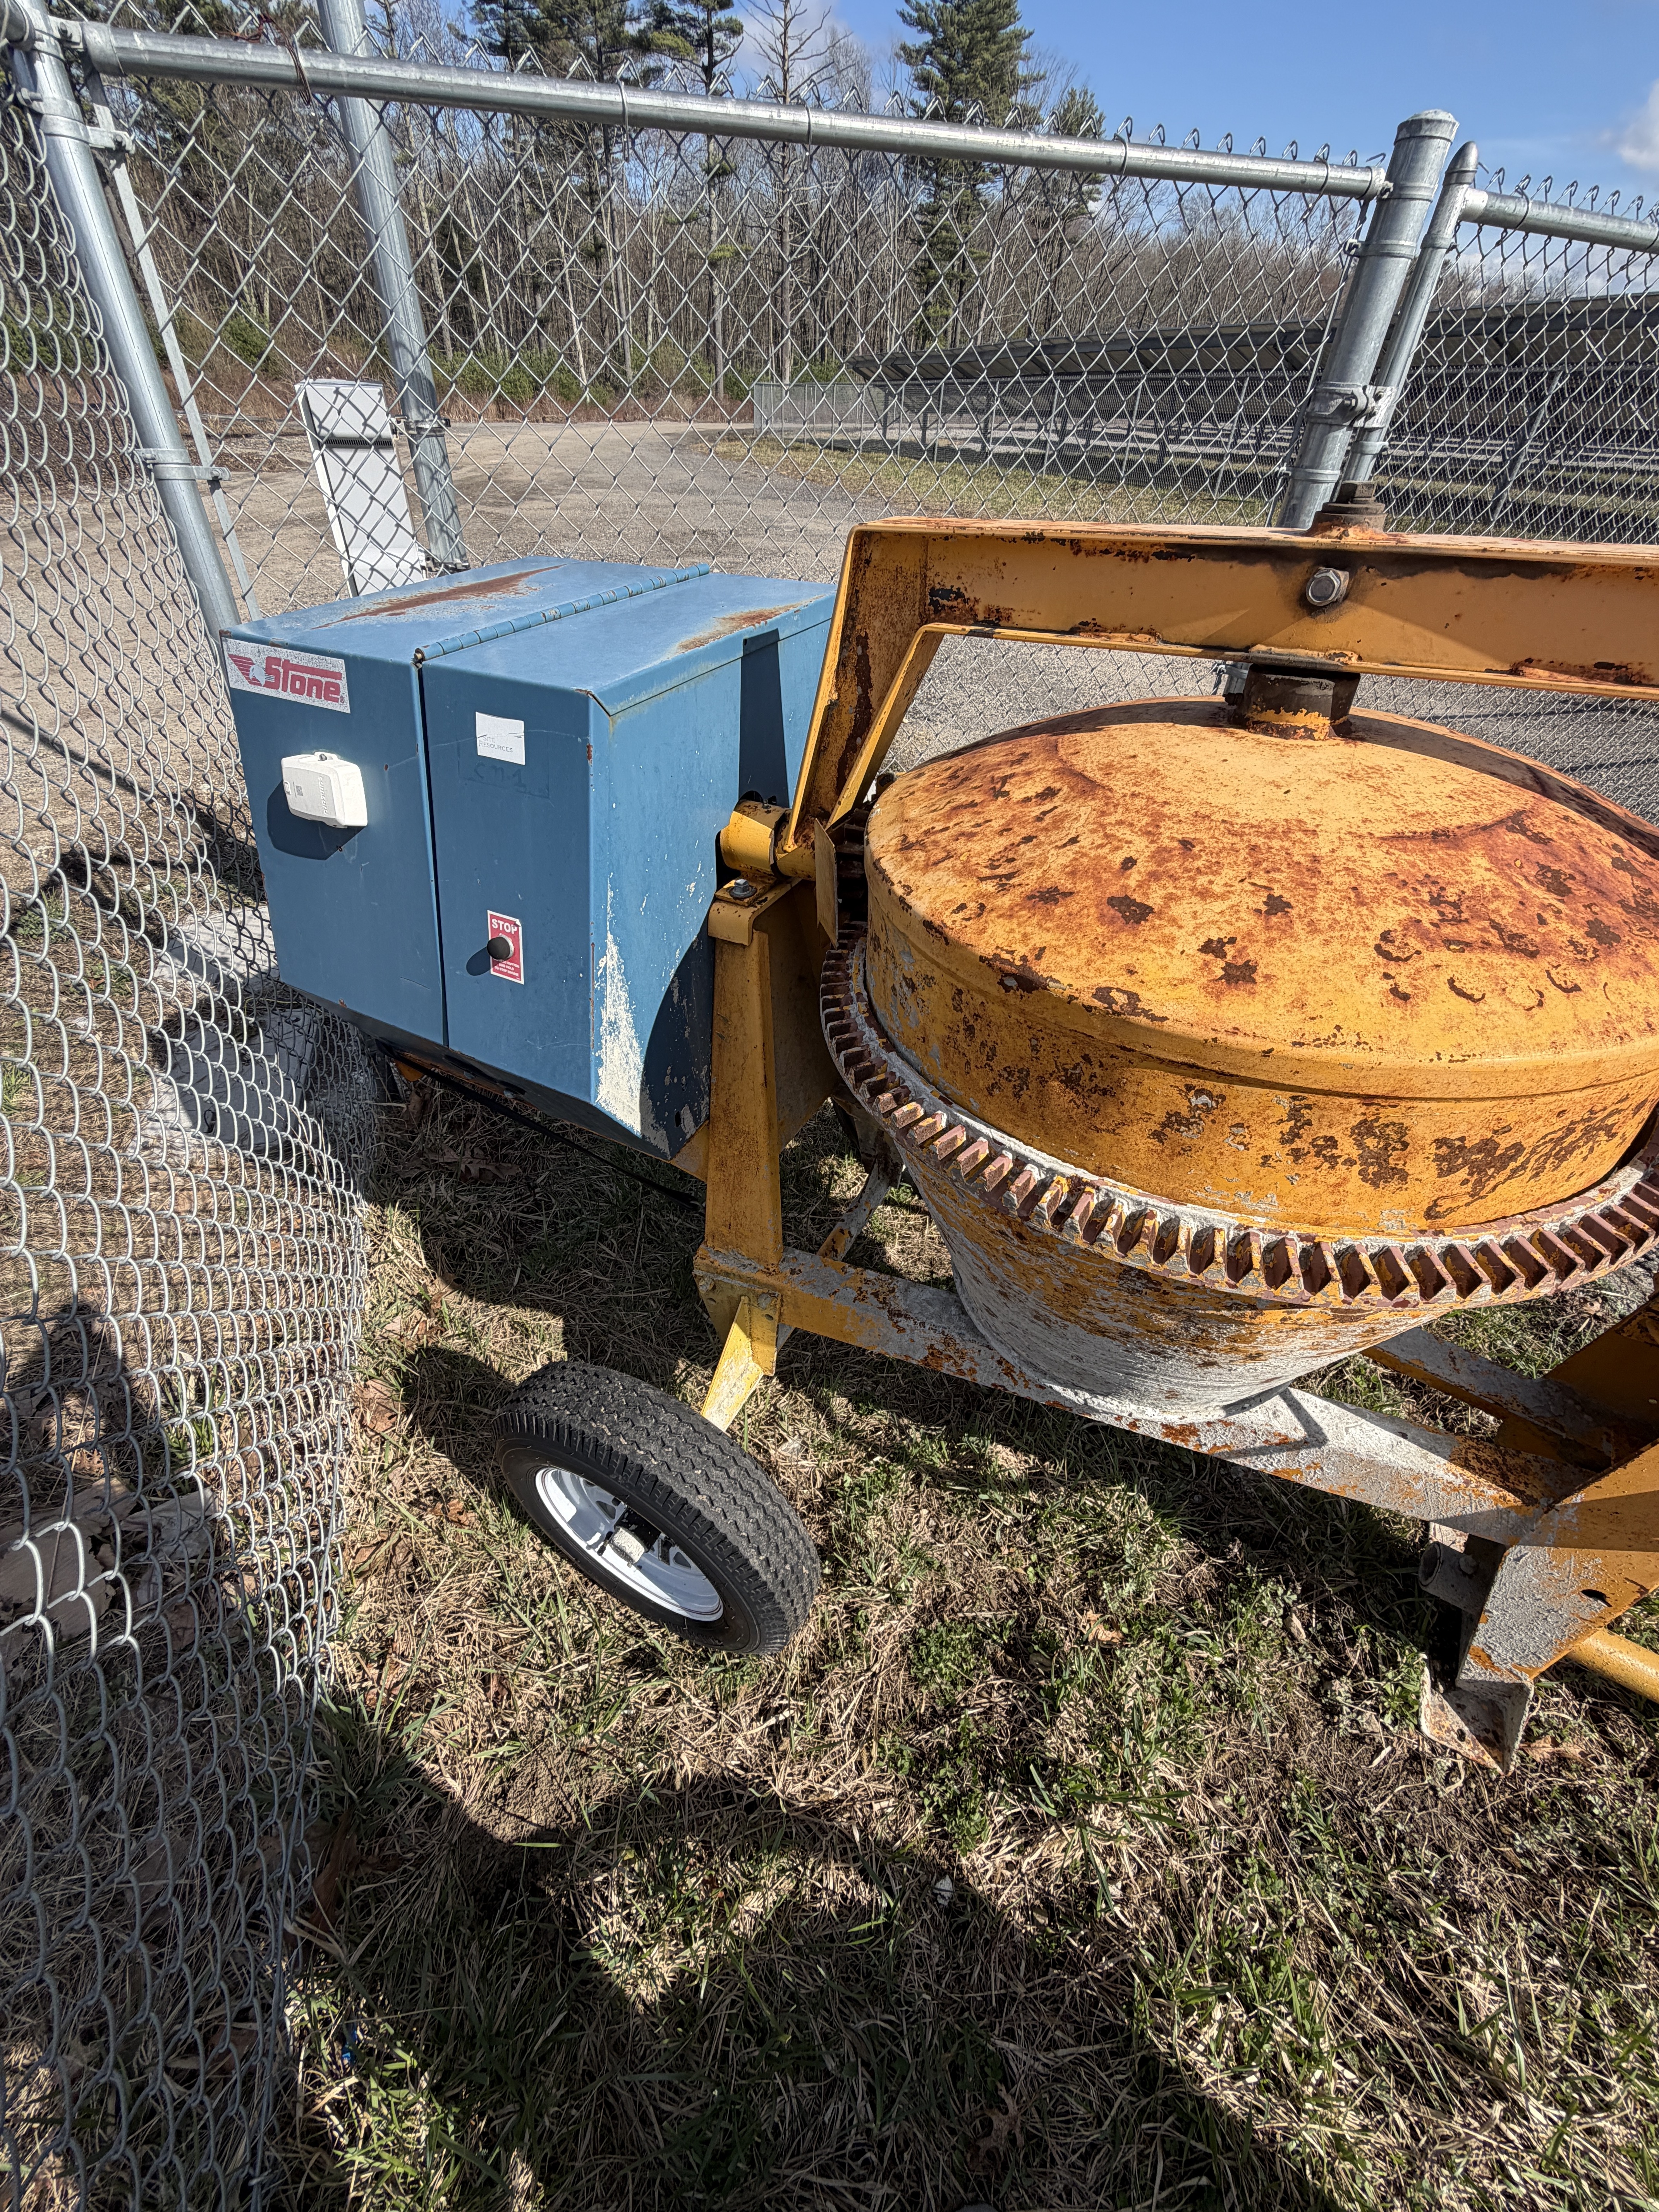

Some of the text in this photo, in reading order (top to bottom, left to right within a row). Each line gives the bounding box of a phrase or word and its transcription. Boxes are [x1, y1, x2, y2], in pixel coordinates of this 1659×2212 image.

[263, 656, 342, 703] Stone
[479, 740, 513, 752] RESOURCES
[491, 919, 517, 934] STOP
